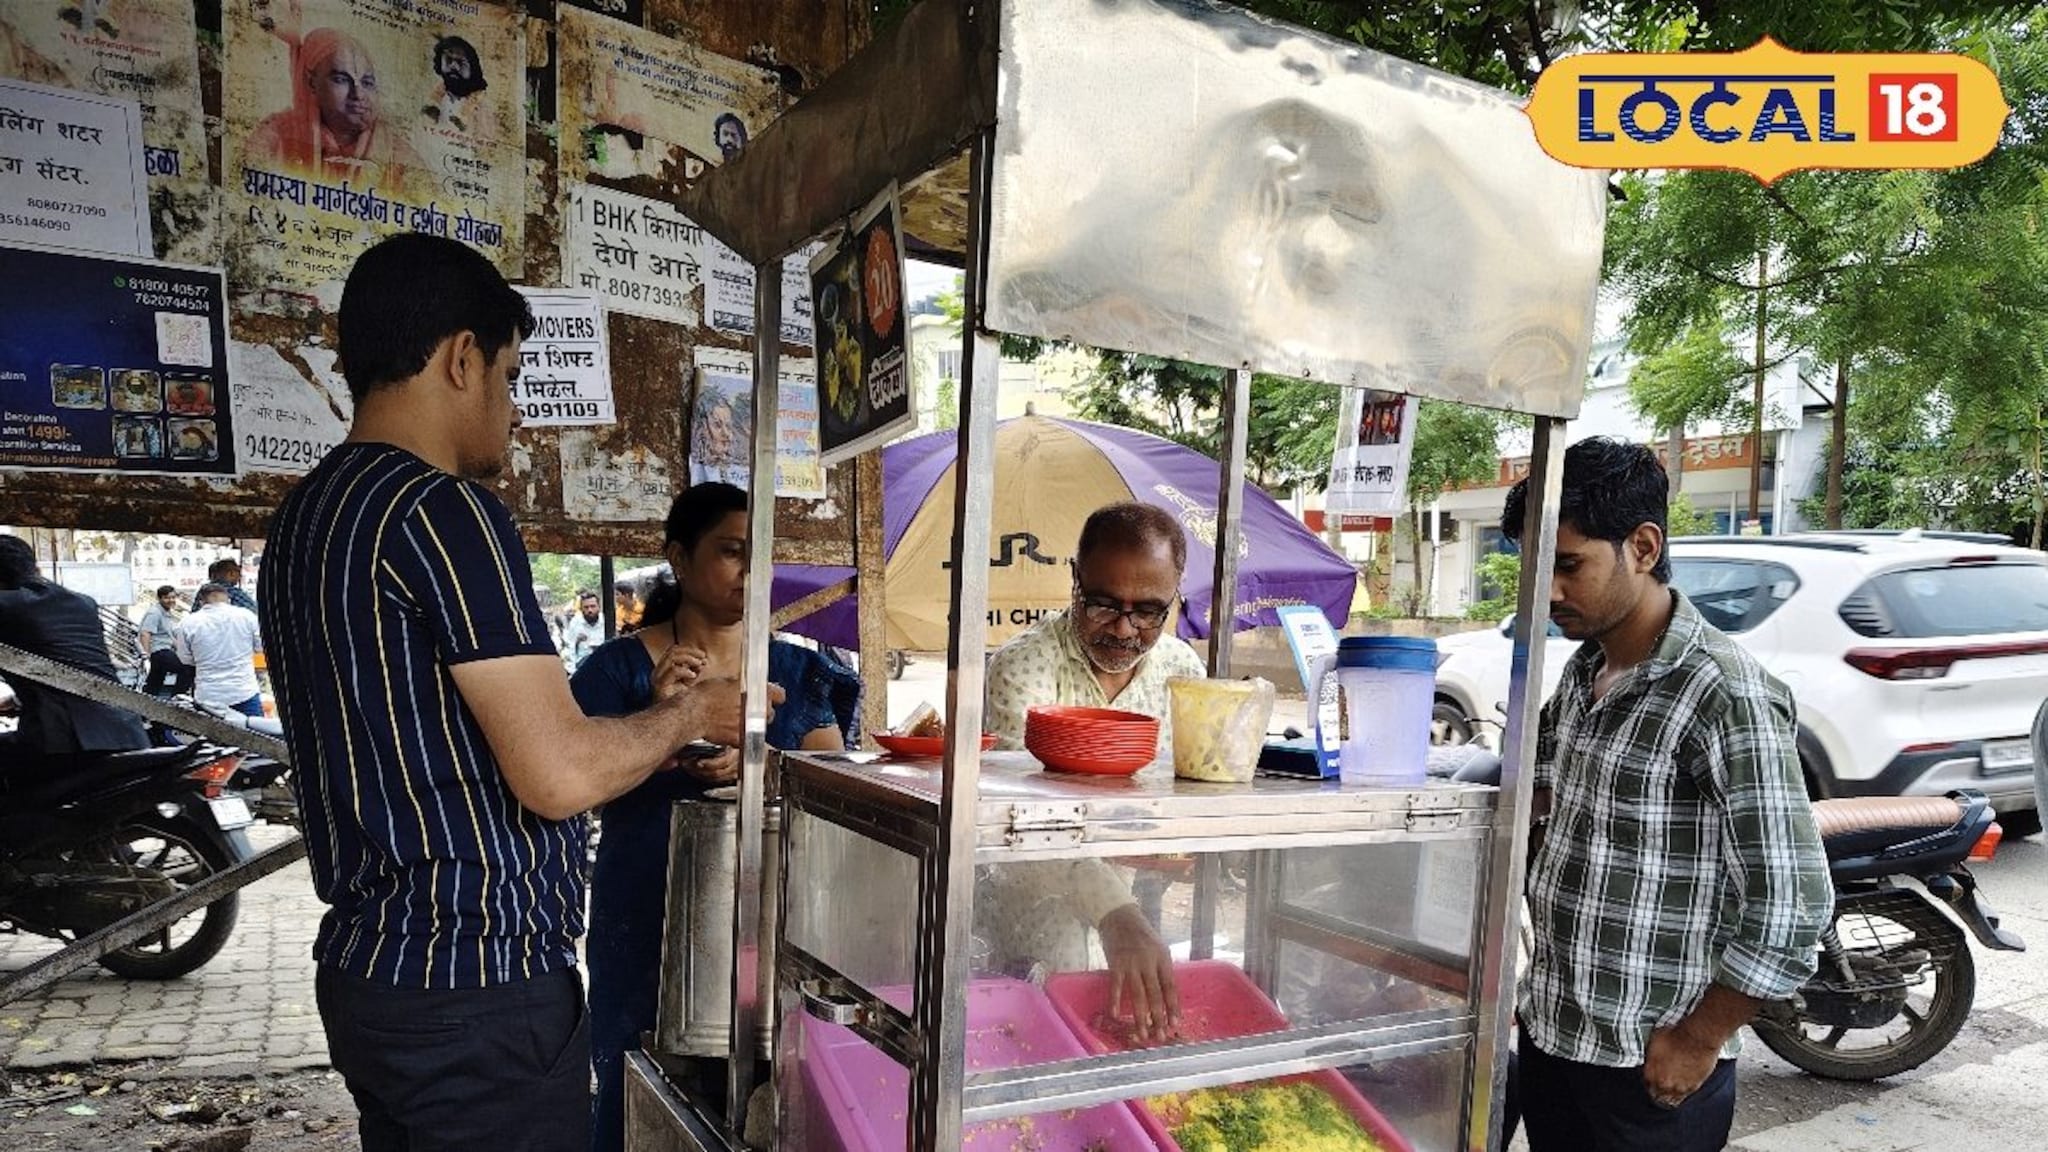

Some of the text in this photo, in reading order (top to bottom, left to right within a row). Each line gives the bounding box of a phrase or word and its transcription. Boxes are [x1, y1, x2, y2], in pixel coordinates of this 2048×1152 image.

[57, 122, 103, 145] शटर
[36, 157, 89, 184] सेंटर.
[27, 197, 106, 217] 8080727090
[241, 167, 503, 249] समस्या मार्गदर्शन व दर्शन सोहळा
[575, 196, 704, 247] 1 BHK किराया
[592, 232, 639, 272] देणे
[648, 252, 702, 285] आहे
[545, 344, 594, 369] शिफ्ट
